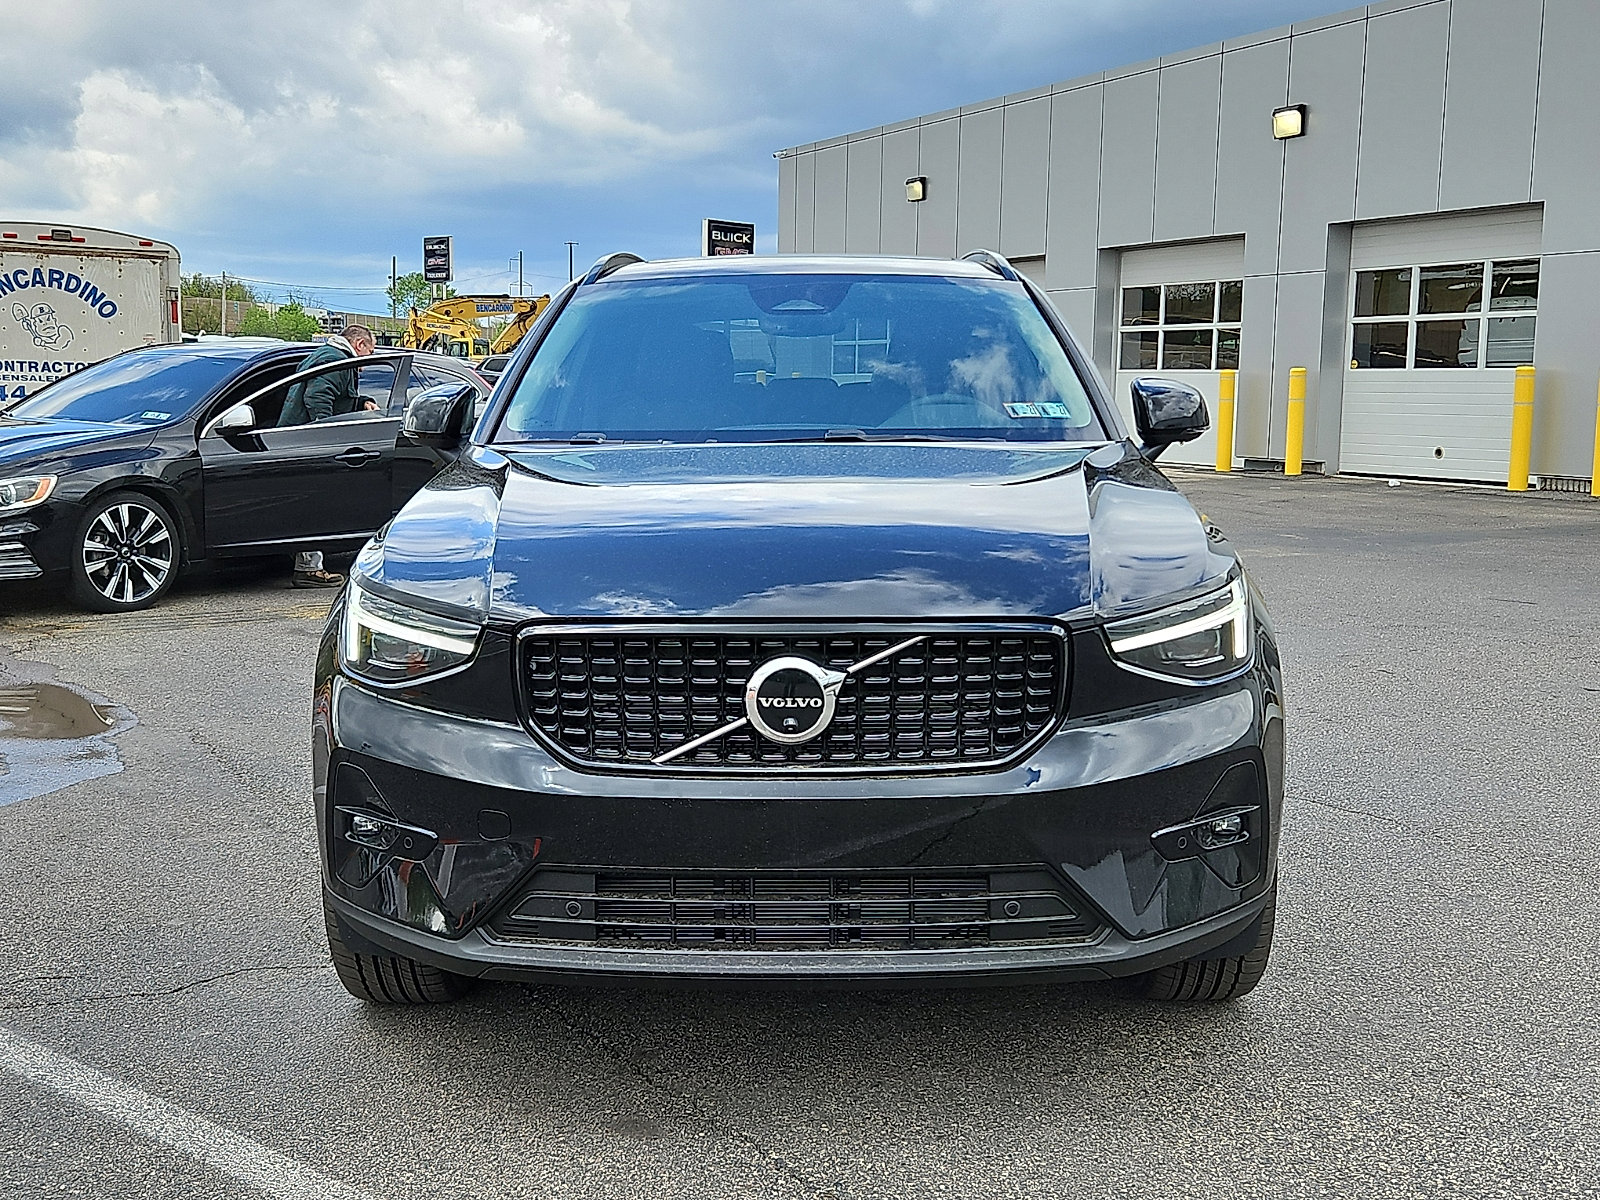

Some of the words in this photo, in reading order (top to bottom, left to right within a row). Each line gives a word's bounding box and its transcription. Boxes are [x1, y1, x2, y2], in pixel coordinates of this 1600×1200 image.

[712, 231, 751, 243] BUICK
[0, 267, 118, 319] NCARDINO
[476, 304, 514, 312] BENCARDINO
[758, 697, 823, 708] VOLVO
